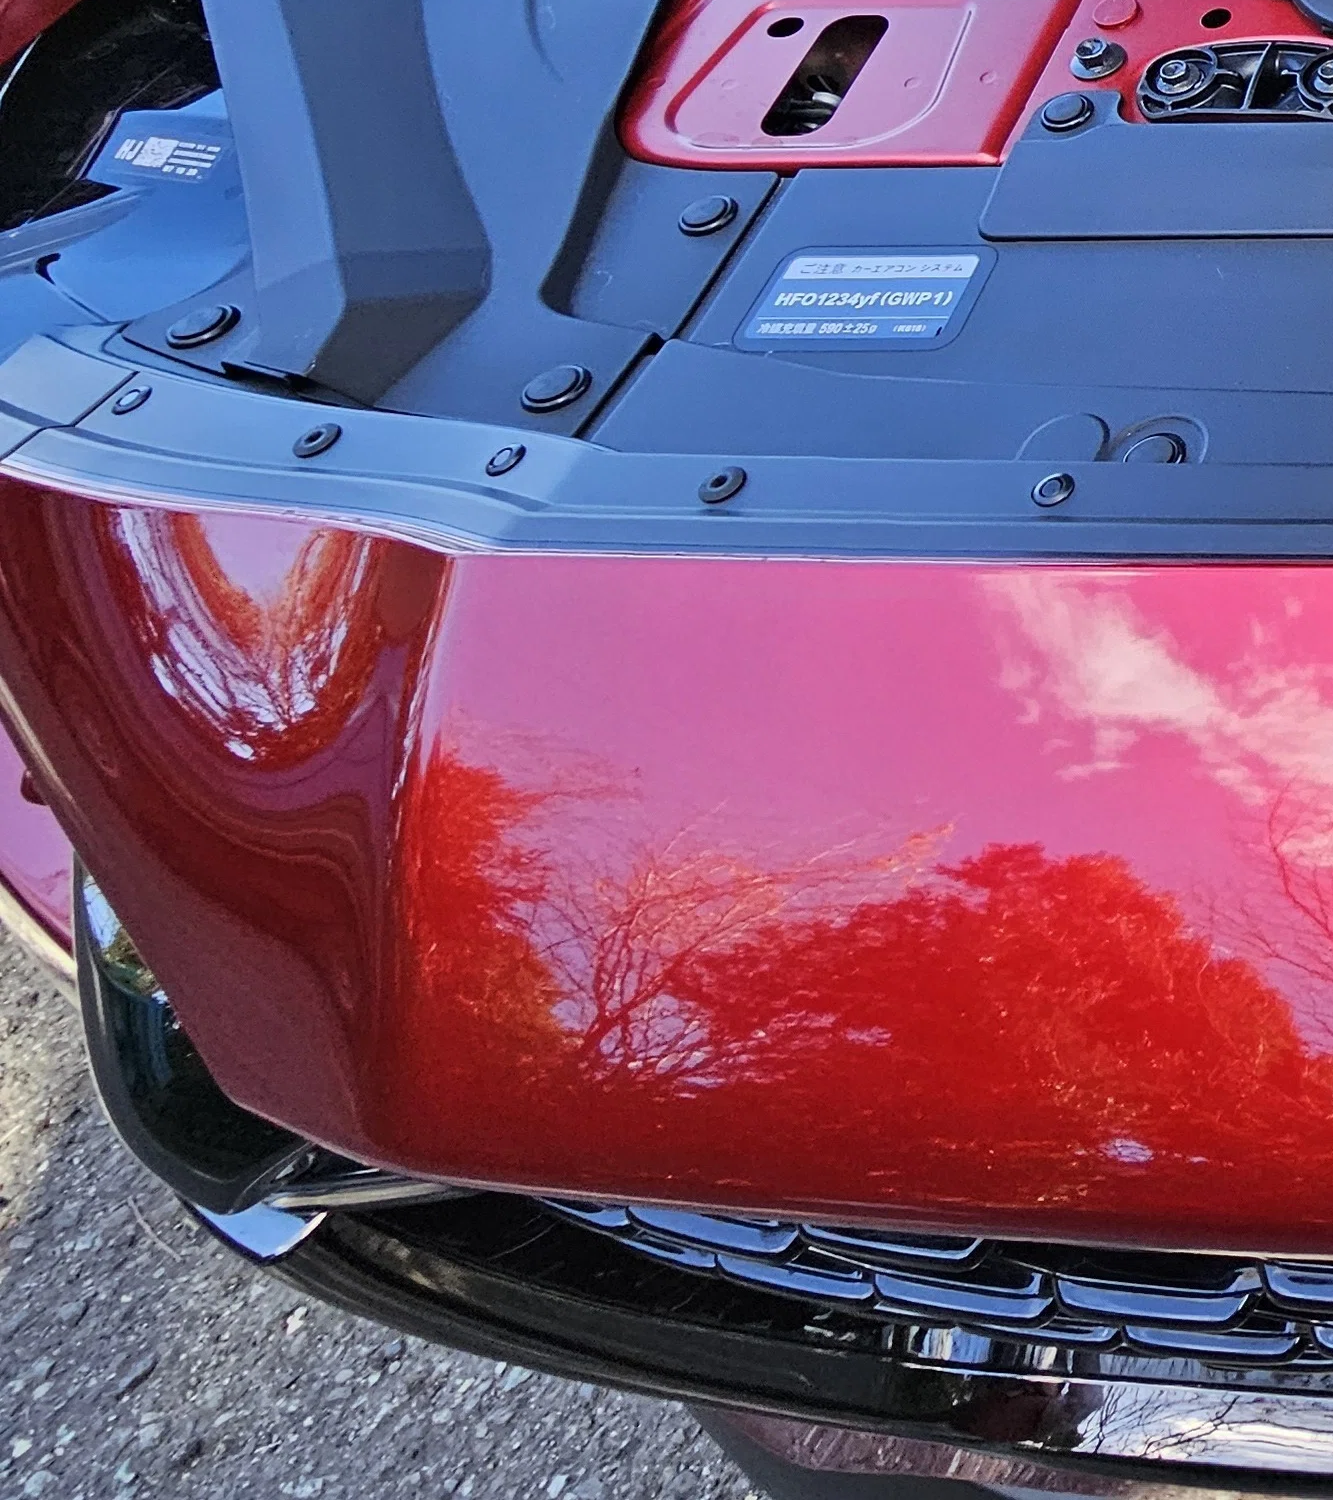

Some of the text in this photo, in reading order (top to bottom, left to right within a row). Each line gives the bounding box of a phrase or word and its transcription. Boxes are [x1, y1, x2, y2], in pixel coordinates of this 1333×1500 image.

[800, 263, 846, 275] ご注意
[919, 262, 963, 273] システム
